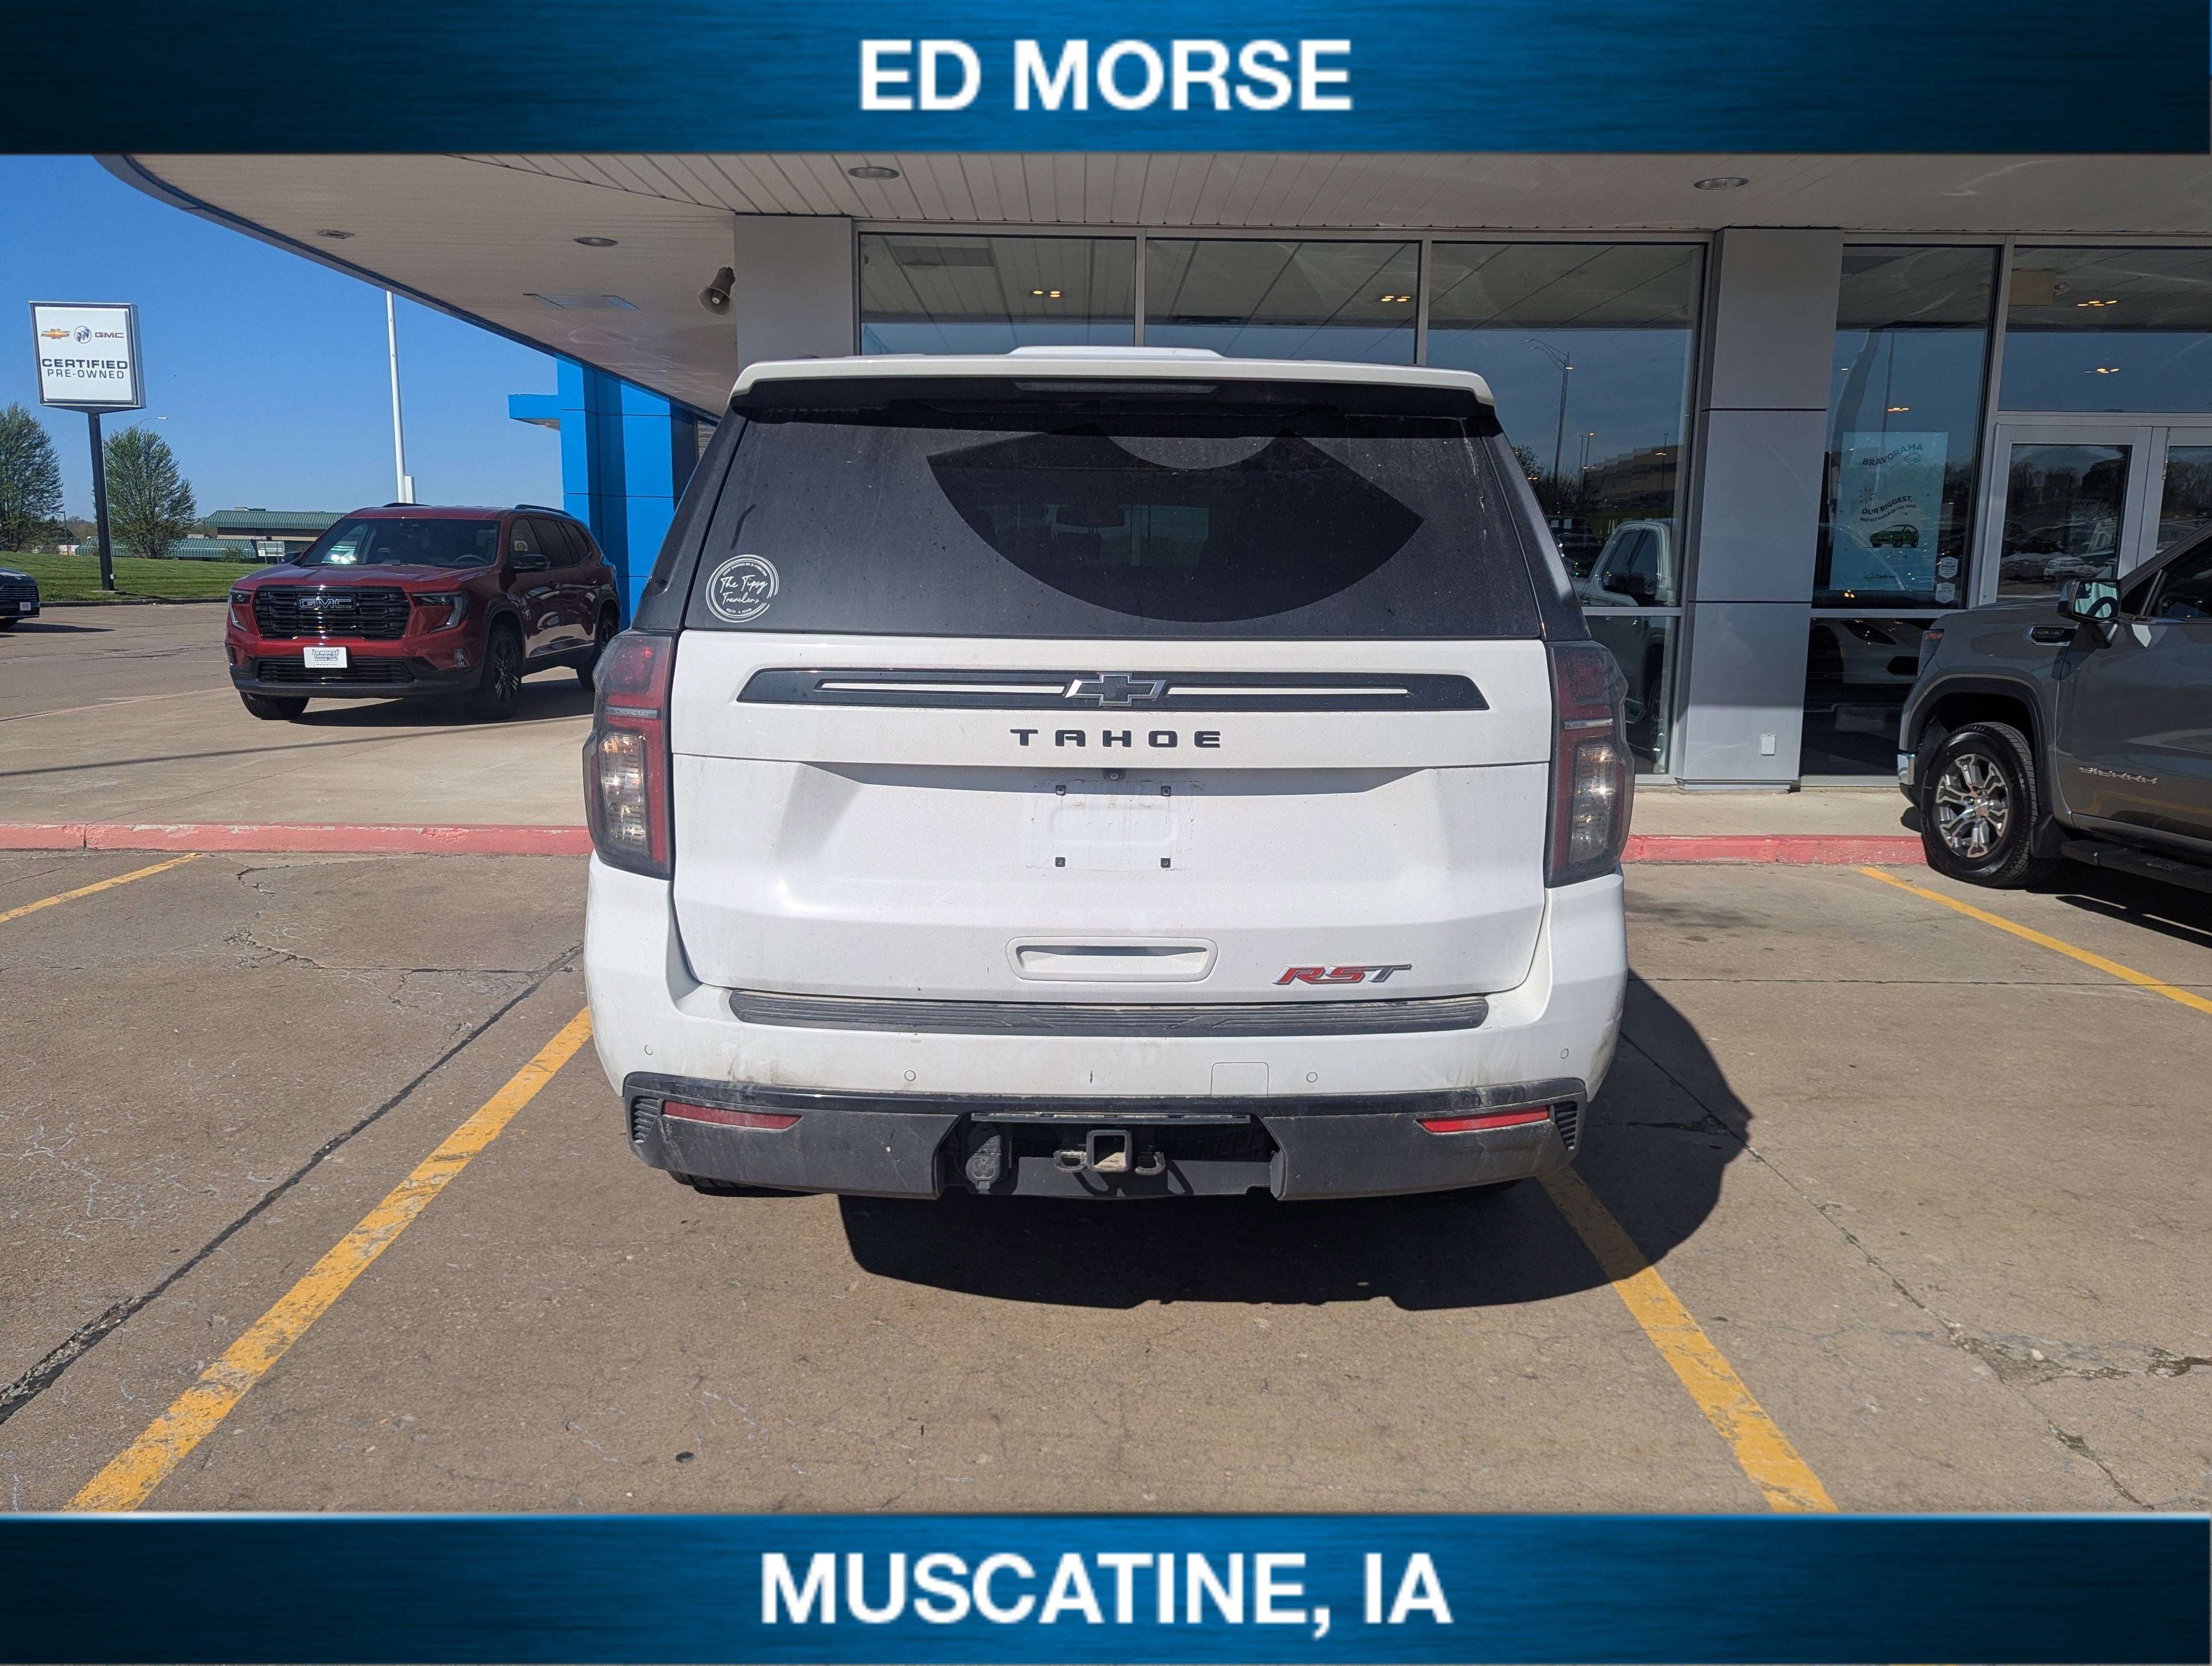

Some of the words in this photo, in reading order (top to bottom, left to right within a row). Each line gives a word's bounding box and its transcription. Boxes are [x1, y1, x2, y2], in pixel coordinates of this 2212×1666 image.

[41, 358, 128, 369] CERTIFIED
[47, 368, 125, 379] PRE-OWNED
[1862, 444, 1924, 466] BRAVORAMA
[1880, 495, 1913, 511] BIGGEST,
[1878, 511, 1891, 521] DEALS
[720, 576, 739, 593] The
[741, 574, 768, 594] Tipsy
[299, 598, 352, 609] GMC
[722, 591, 760, 605] Travelers
[615, 708, 650, 716] CHEVROLET
[1009, 728, 1221, 748] TAHOE
[2079, 767, 2157, 784] SIERRA
[1272, 962, 1413, 986] RST
